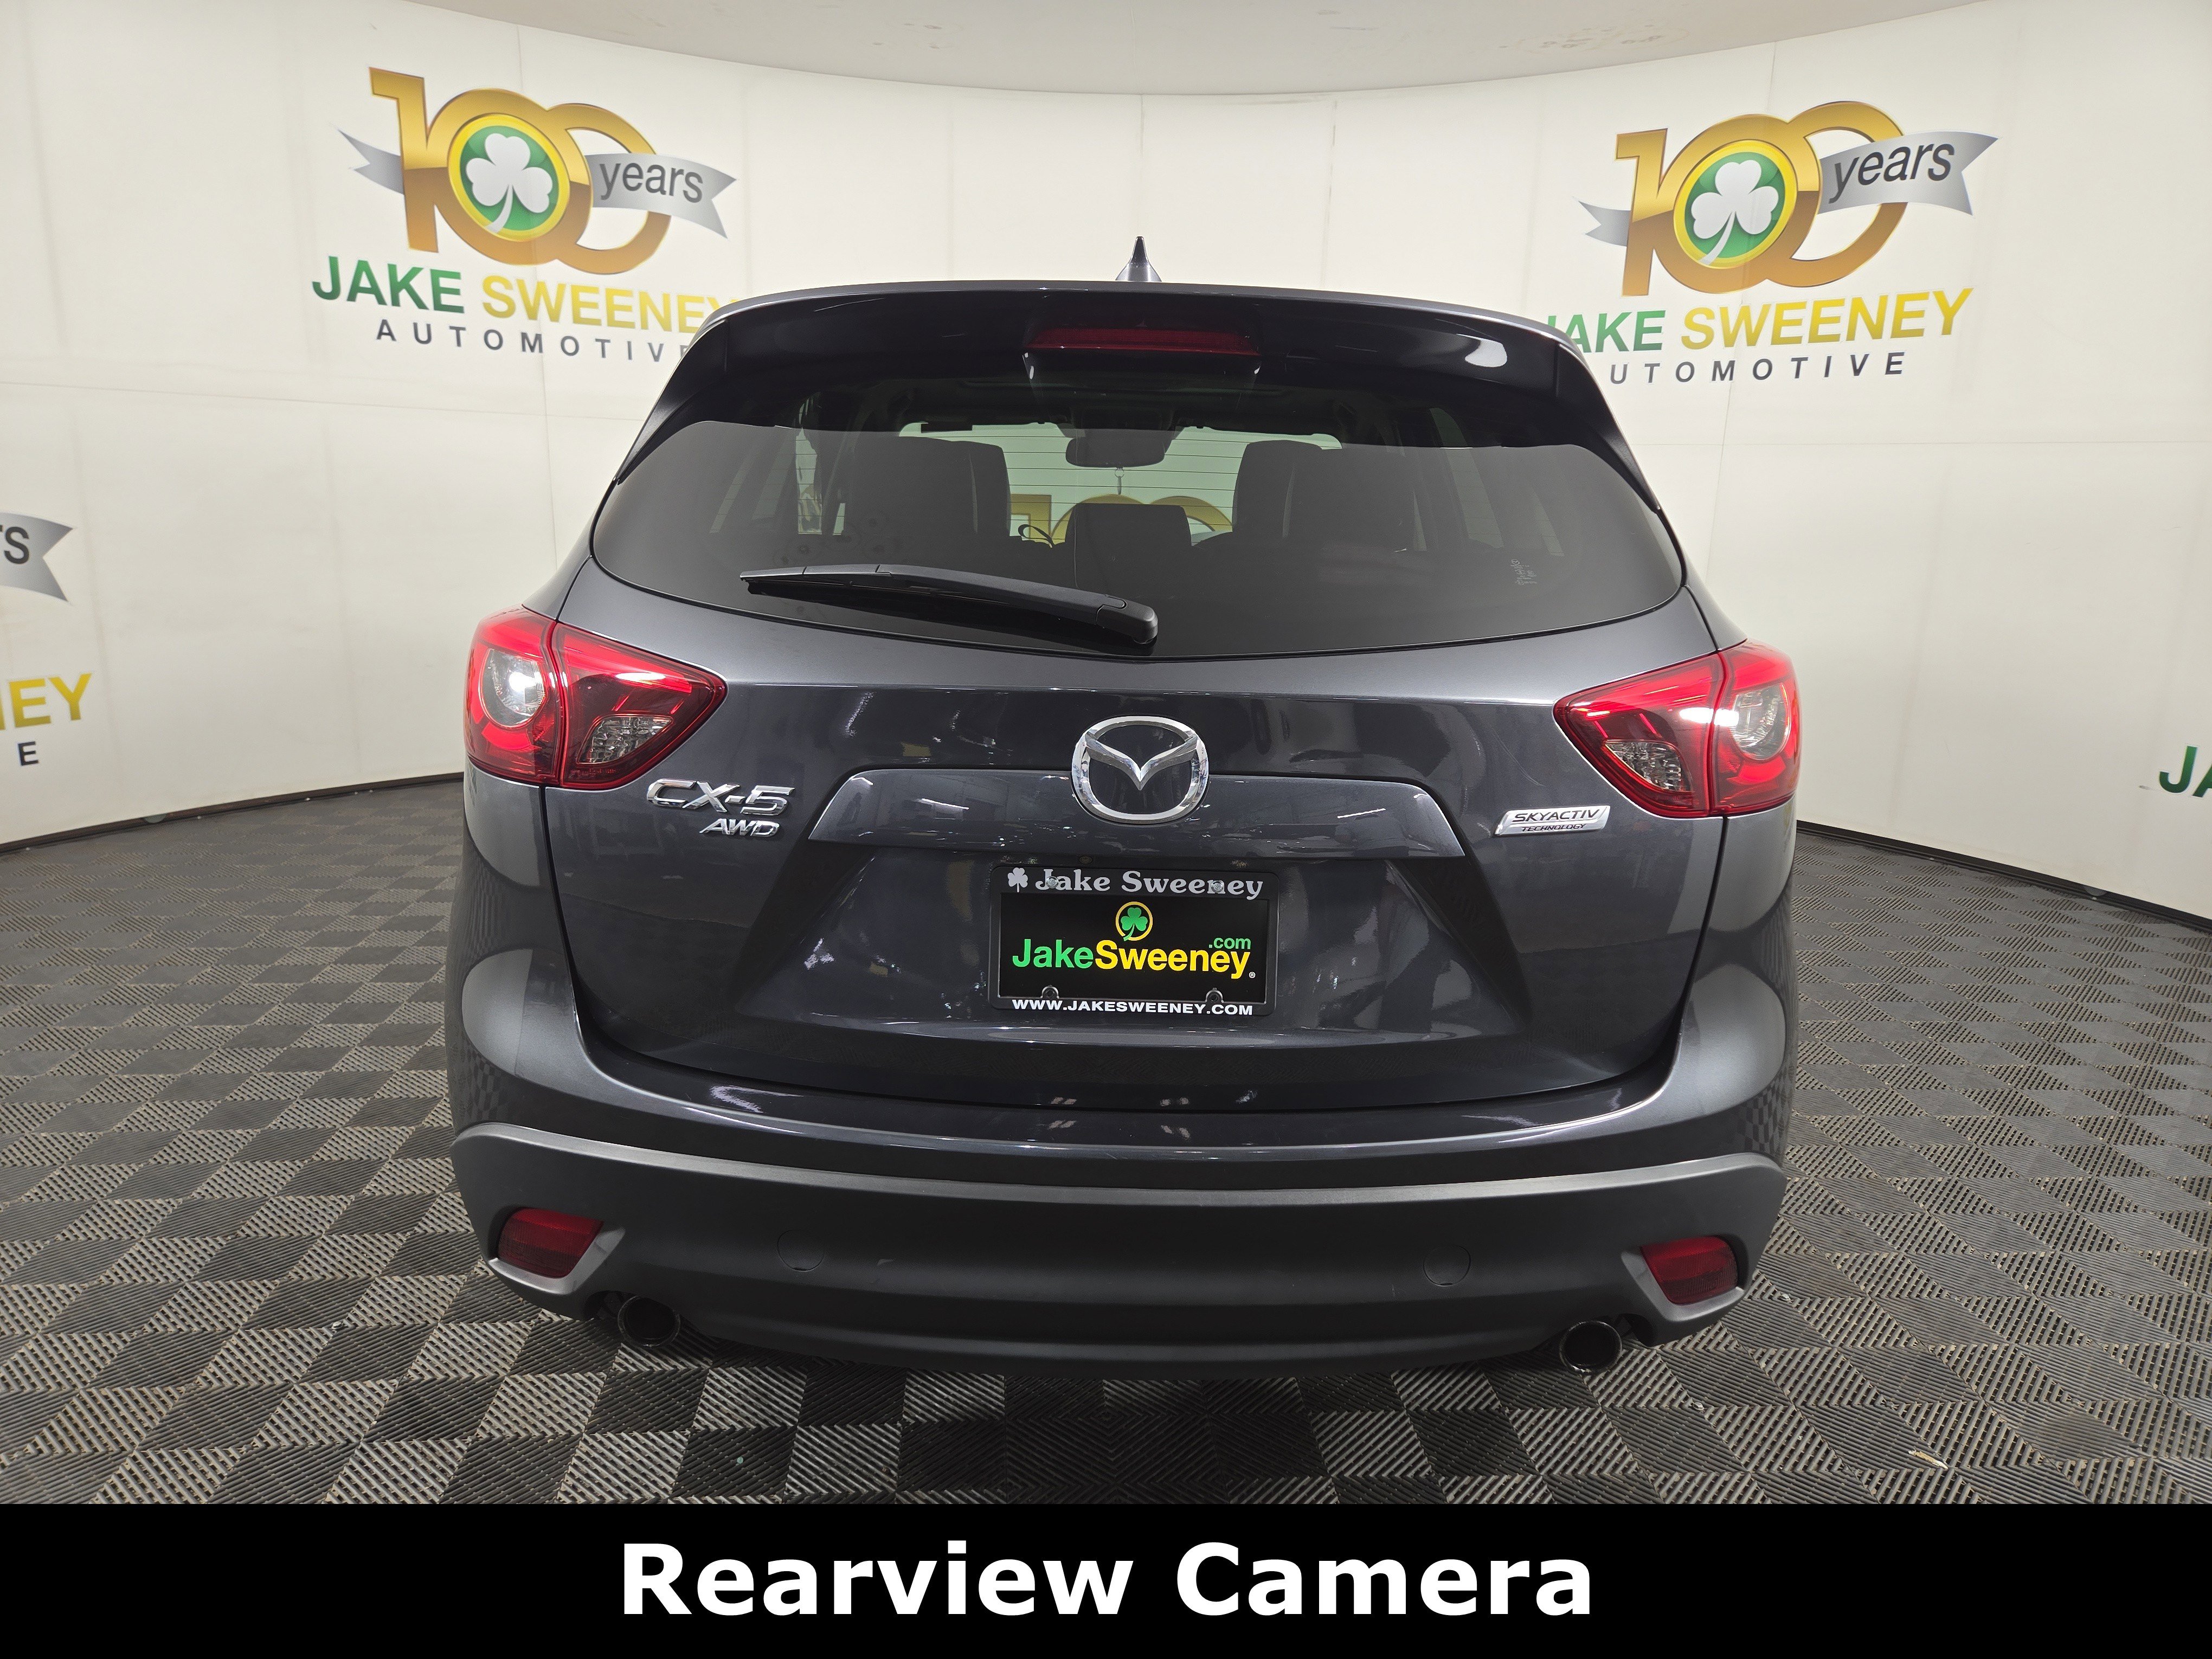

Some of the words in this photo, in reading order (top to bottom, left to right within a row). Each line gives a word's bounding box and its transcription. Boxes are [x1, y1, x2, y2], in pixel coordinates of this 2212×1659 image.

[369, 67, 671, 275] 100
[600, 162, 703, 203] years
[1616, 100, 1908, 297] 100
[1829, 143, 1954, 204] years
[312, 256, 465, 314] JAKE
[1548, 310, 1666, 353] AKE
[1680, 288, 1974, 350] SWEENEY
[1610, 351, 1905, 384] UTOMOTIVE
[647, 778, 795, 815] CX-5
[699, 818, 780, 837] AWD
[1512, 809, 1600, 822] SKYACTIV
[1521, 824, 1587, 832] TECHNOLOGY
[1035, 869, 1111, 891] Jake
[1012, 999, 1253, 1015] WWW.JAKESWEENEY.COM
